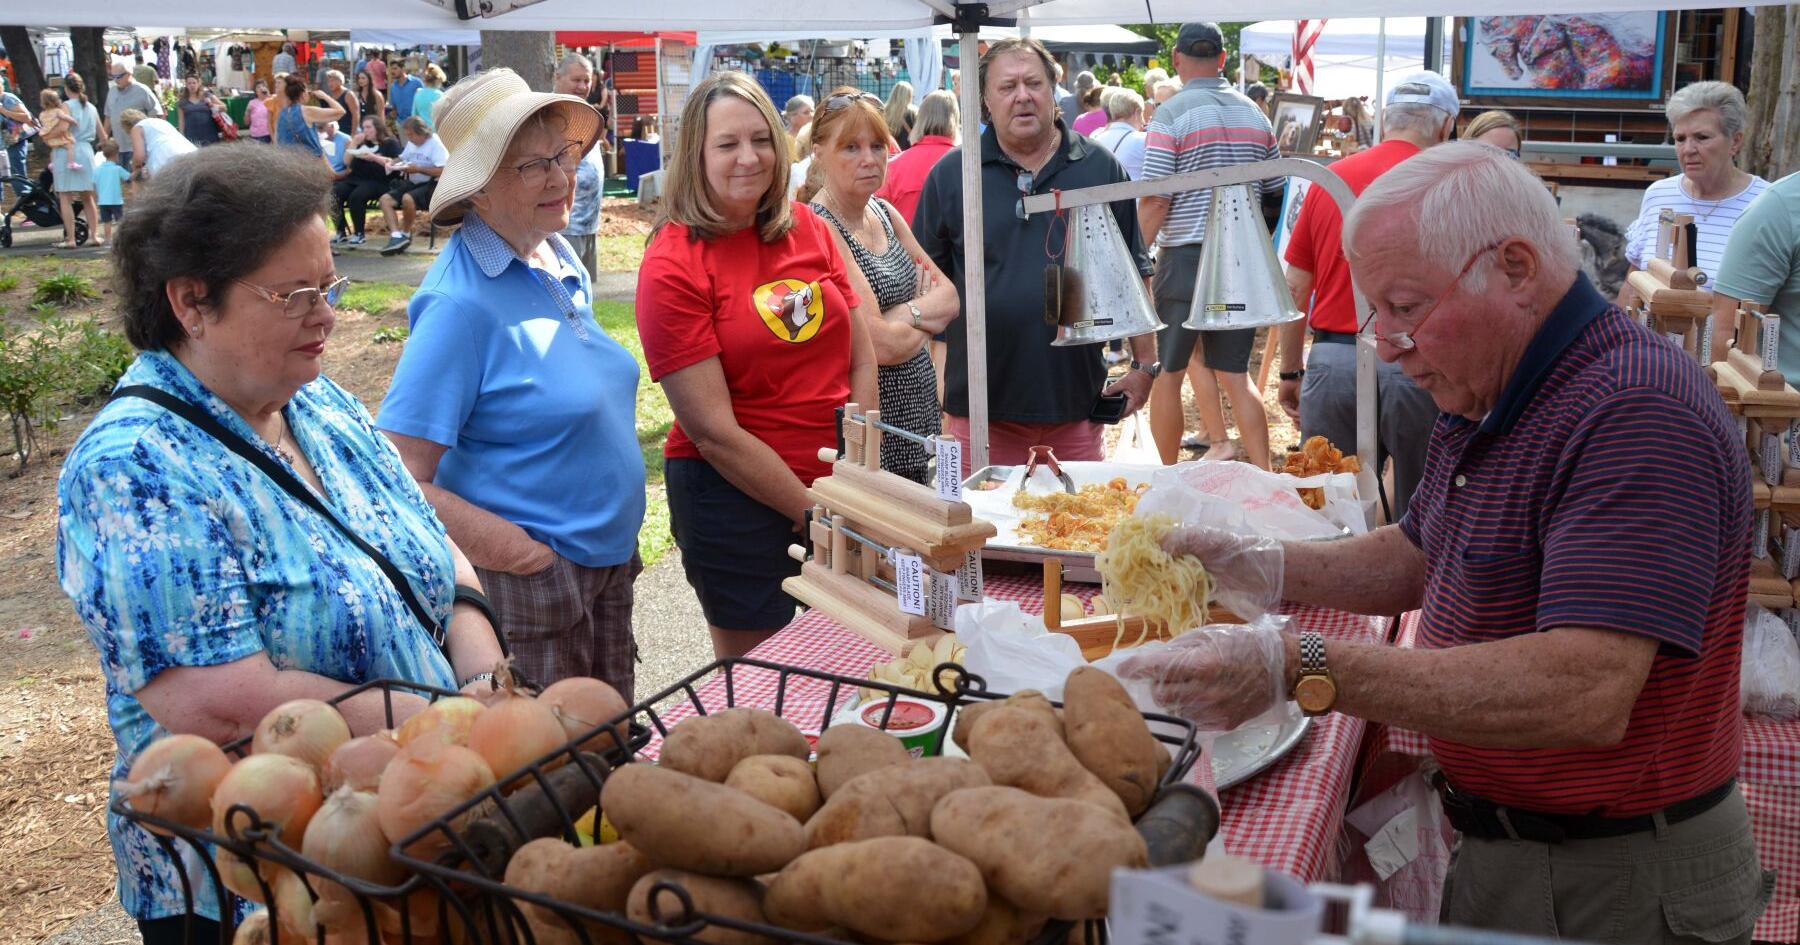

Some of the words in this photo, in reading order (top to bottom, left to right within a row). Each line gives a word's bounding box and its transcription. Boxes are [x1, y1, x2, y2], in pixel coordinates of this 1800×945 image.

[950, 446, 958, 497] CAUTION!
[912, 560, 920, 610] CAUTION!
[968, 550, 978, 596] CAUTION!
